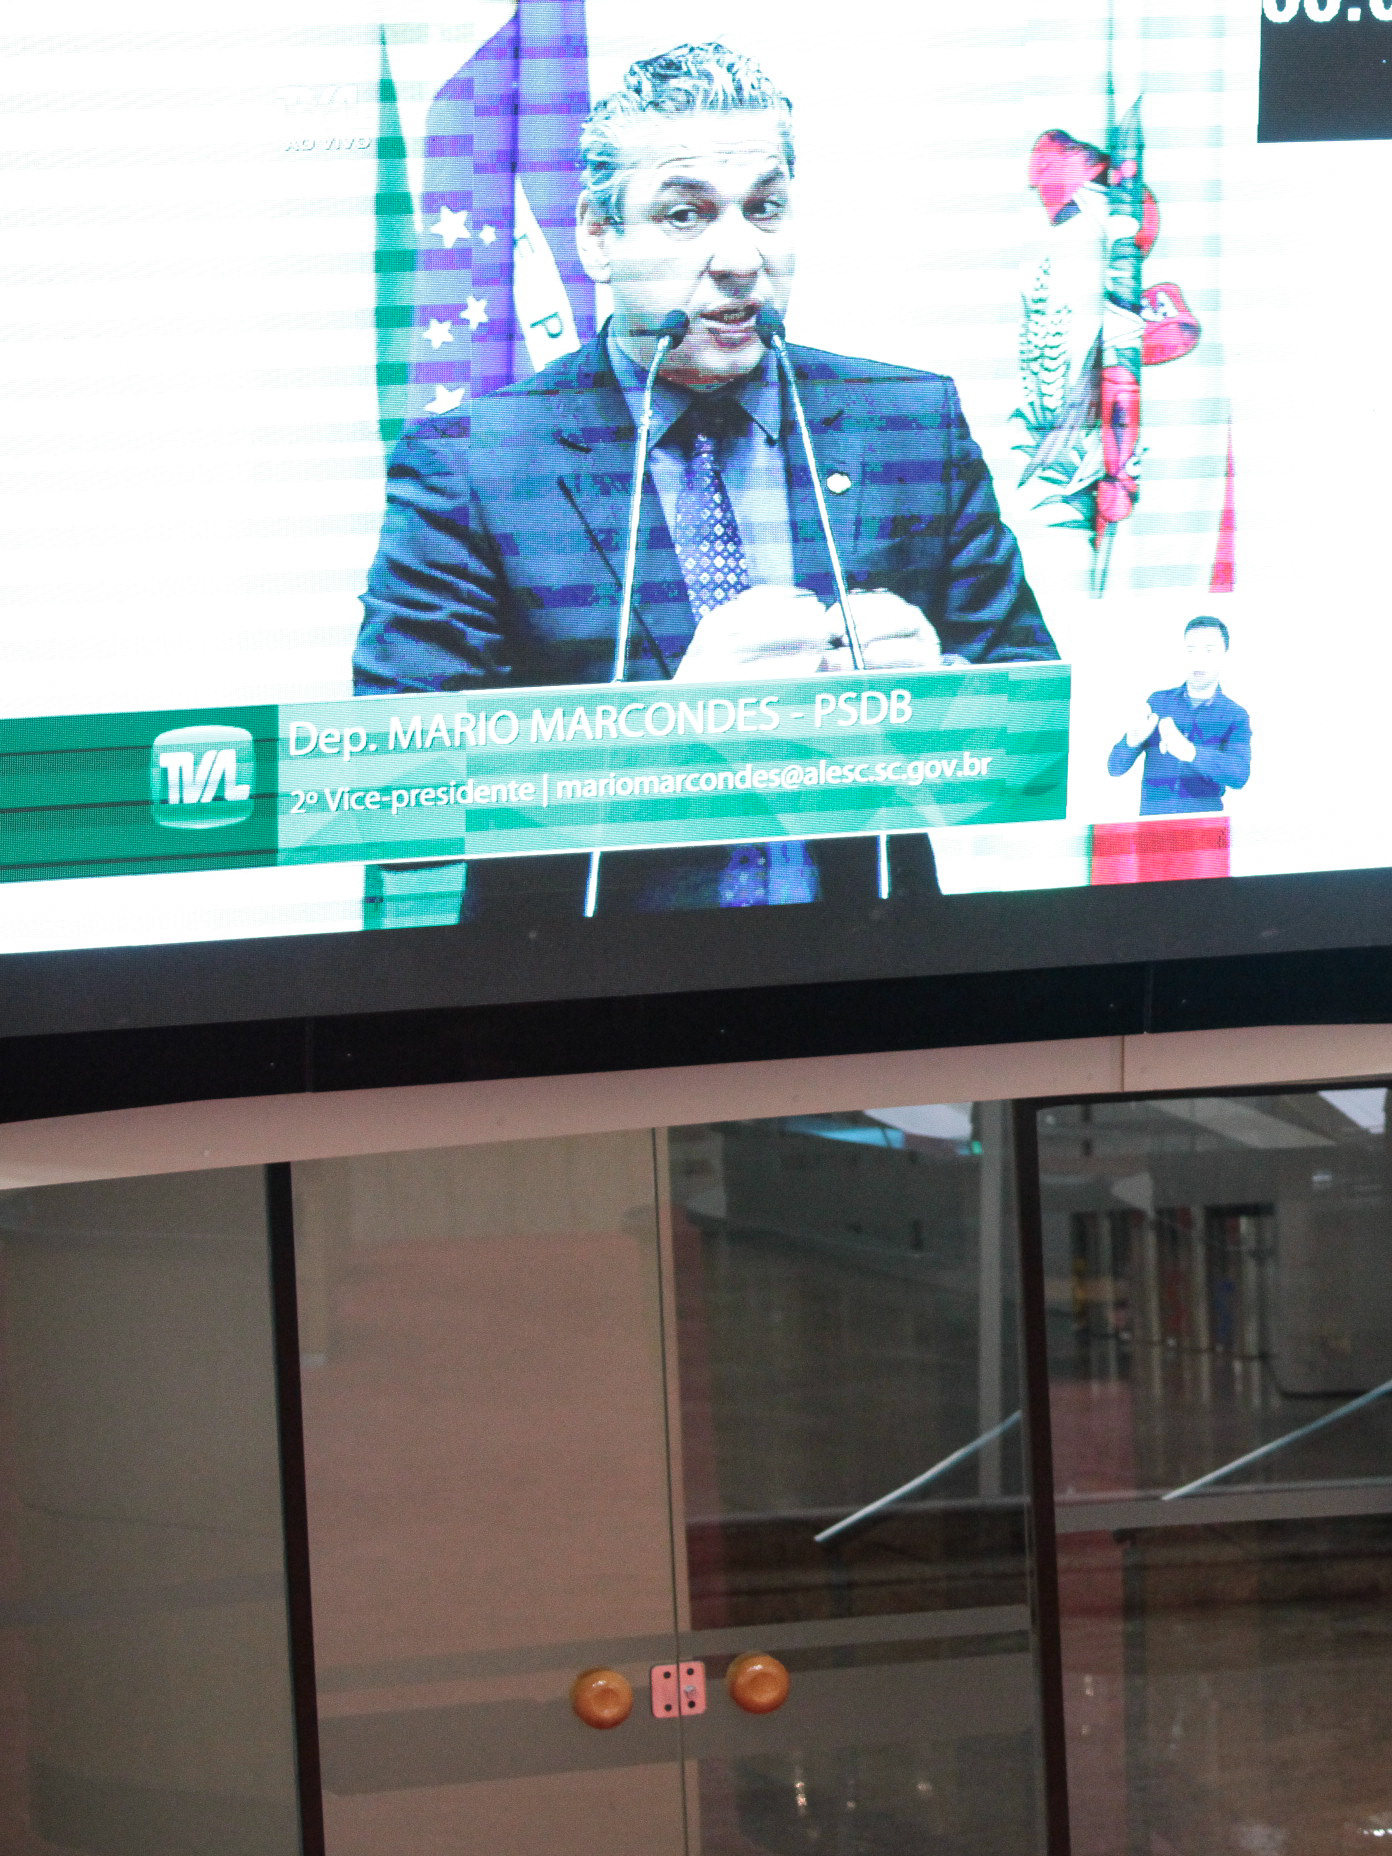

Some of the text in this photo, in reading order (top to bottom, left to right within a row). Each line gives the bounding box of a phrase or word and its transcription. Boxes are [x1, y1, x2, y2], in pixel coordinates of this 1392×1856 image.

[289, 720, 378, 761] Dep.
[387, 709, 519, 751] MARIO
[530, 695, 781, 743] MARCONDES
[814, 688, 913, 728] PSDB
[324, 776, 534, 815] Vice-presidente
[556, 750, 992, 799] mariomarcondes@alesc.sc.gov.br
